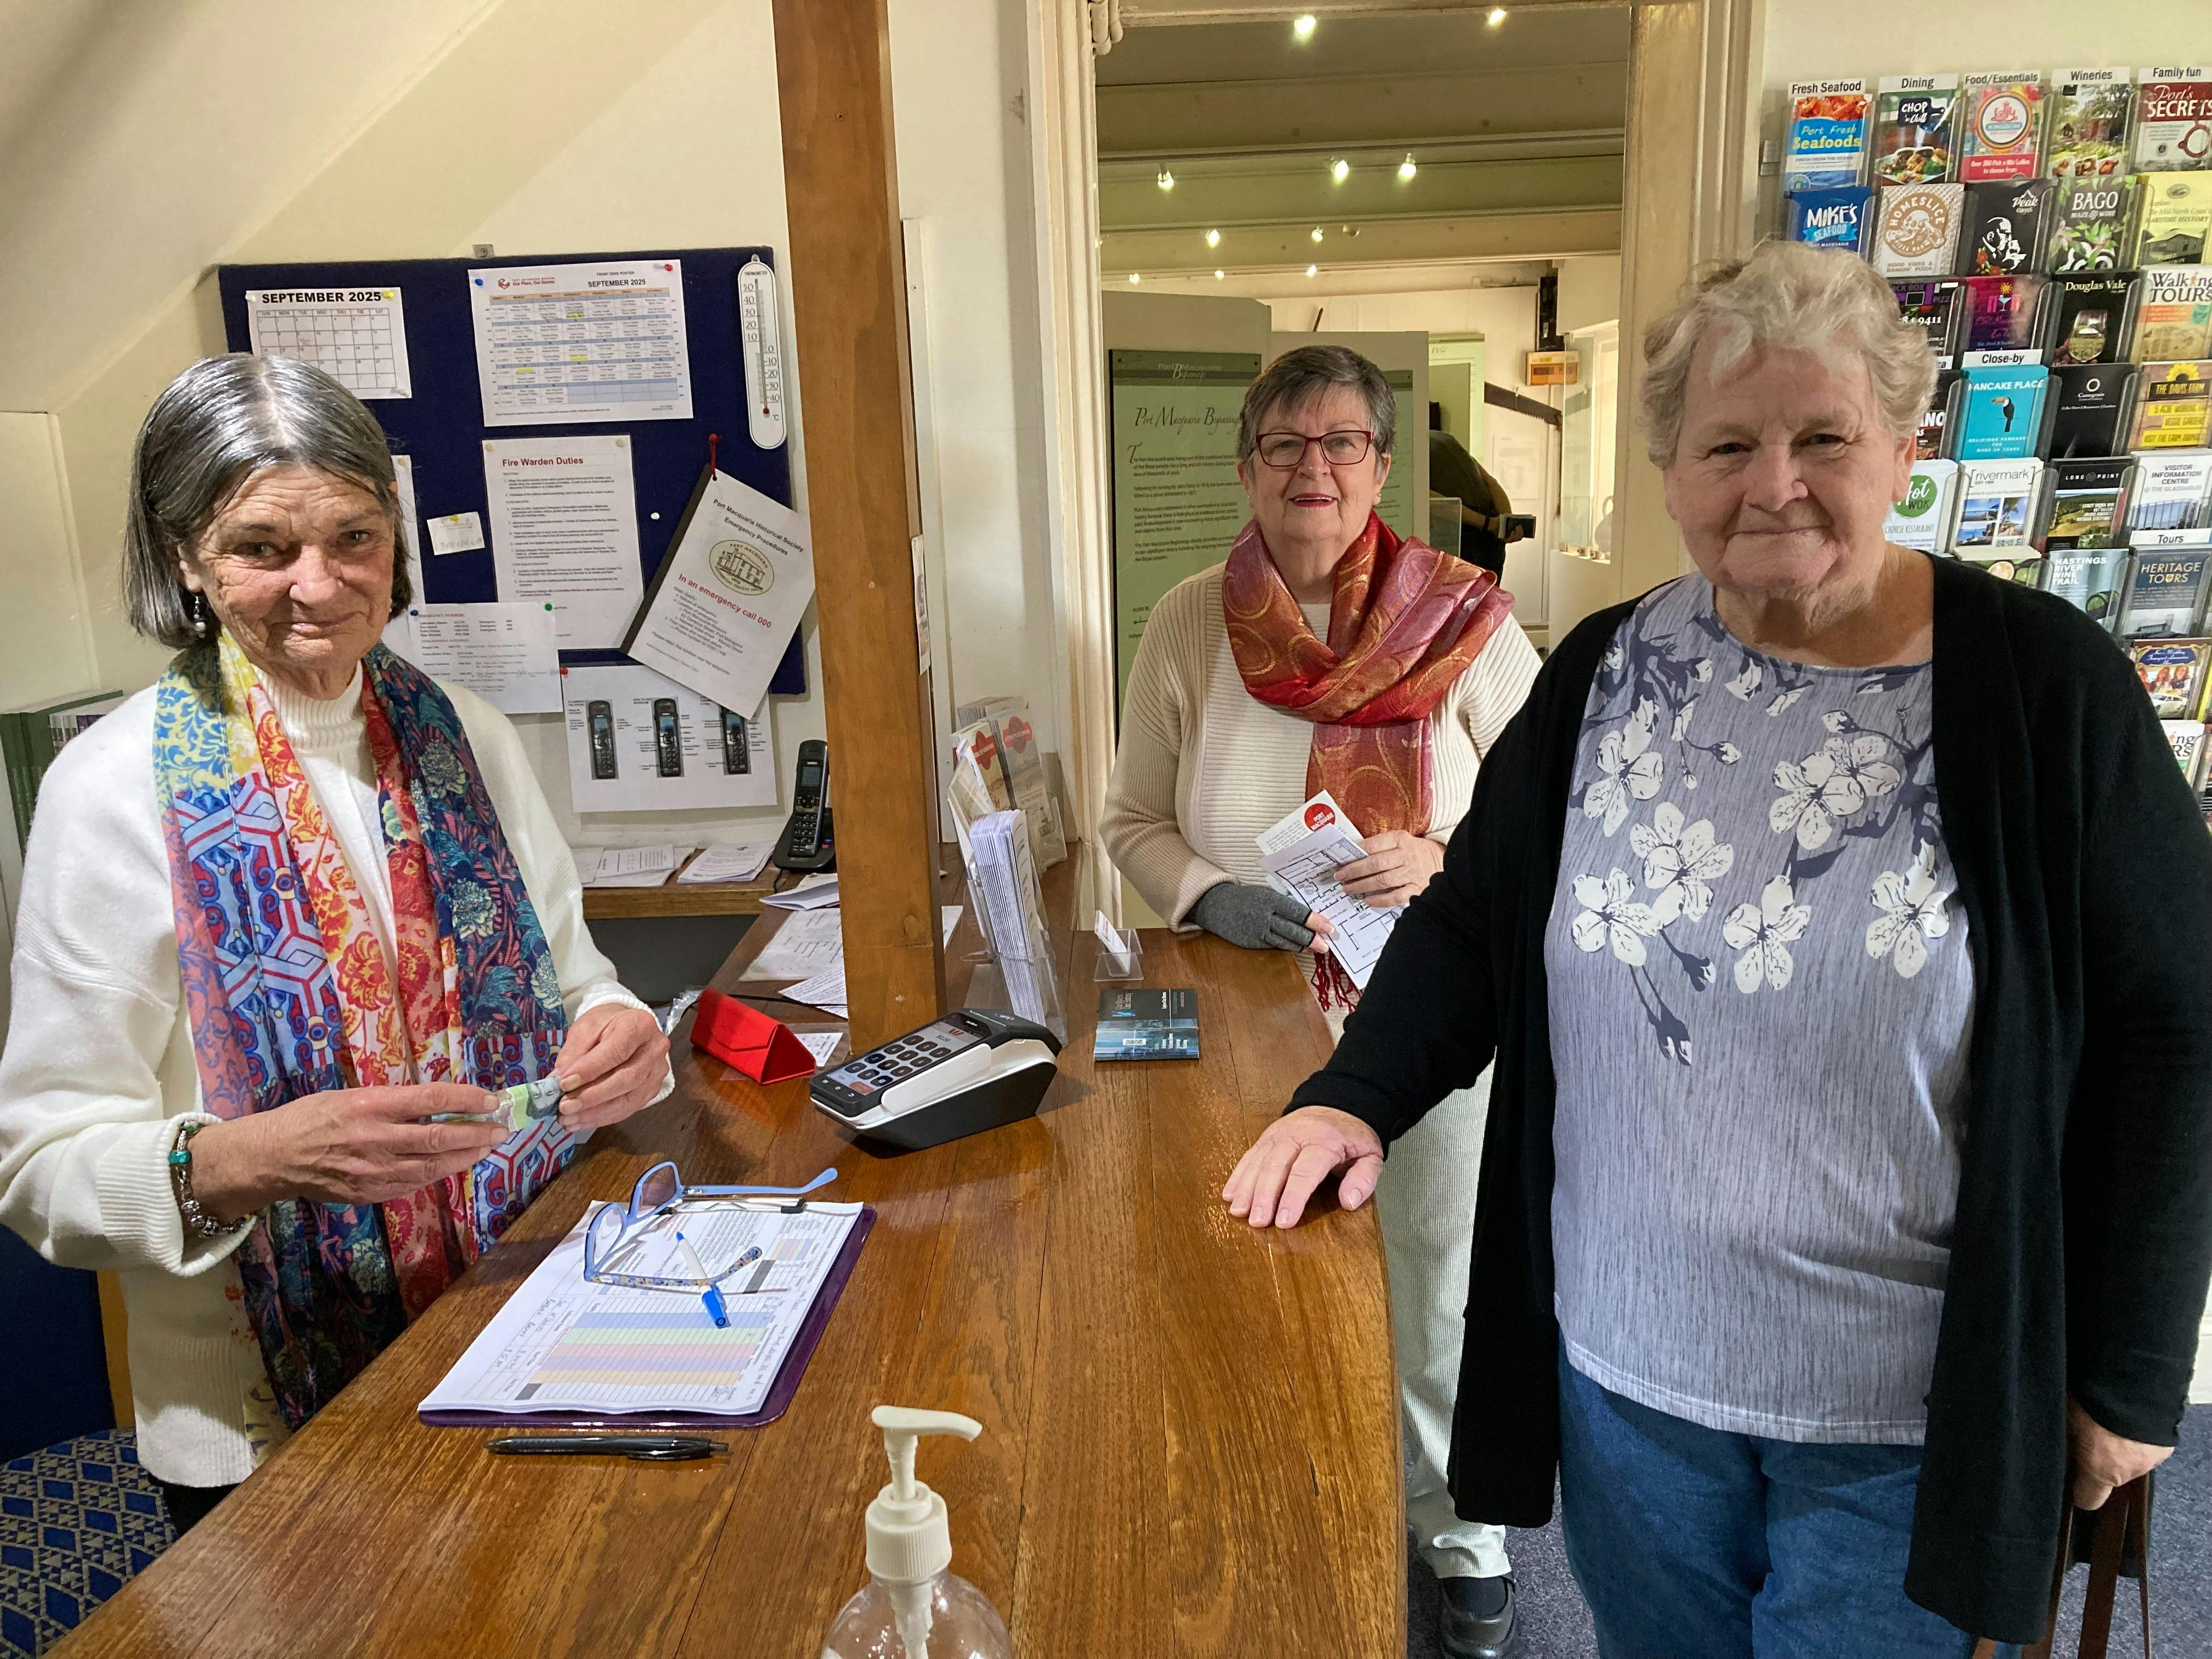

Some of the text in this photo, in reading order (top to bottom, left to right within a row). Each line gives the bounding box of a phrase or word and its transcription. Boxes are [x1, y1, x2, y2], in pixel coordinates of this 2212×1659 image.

[1965, 73, 2038, 84] Food/Essentials
[2071, 71, 2113, 81] Wineries
[2153, 67, 2201, 79] Family fun
[1792, 81, 1861, 94] Fresh Seafood
[1901, 78, 1934, 89] Dining
[2155, 85, 2193, 101] Port's
[1901, 103, 1928, 112] CHOP
[2147, 100, 2212, 117] SECRETS
[1802, 124, 1857, 135] Port Fresh
[1793, 135, 1861, 149] Seafoods
[2012, 196, 2038, 209] Peak
[2072, 191, 2119, 211] BAGO
[1807, 203, 1858, 228] MIKE'S
[1889, 197, 1945, 226] HOMESLICE
[1814, 224, 1847, 241] SEAFOOD
[2066, 280, 2127, 293] Douglas Vale
[262, 292, 381, 303] SEPTEMBER 2025
[2151, 288, 2212, 303] TOURS
[1918, 316, 1942, 325] 9411
[1982, 354, 2025, 364] Close-by
[1968, 380, 2044, 391] PANCAKE PLACE
[2156, 384, 2168, 394] THE
[1135, 407, 1200, 436] Port Macquarie
[503, 456, 583, 467] Fire Warden Duties
[712, 499, 805, 552] Port Macquarie Historical Society
[1905, 524, 1934, 533] RESTAURANT
[724, 517, 789, 556] Emergency Procedures
[2158, 535, 2184, 544] Tours
[2141, 562, 2202, 573] HERITAGE
[2149, 573, 2189, 584] TOURS
[678, 574, 772, 629] In an emergency call 000
[1310, 812, 1334, 831] MACQUARIE
[1313, 812, 1324, 821] PORT
